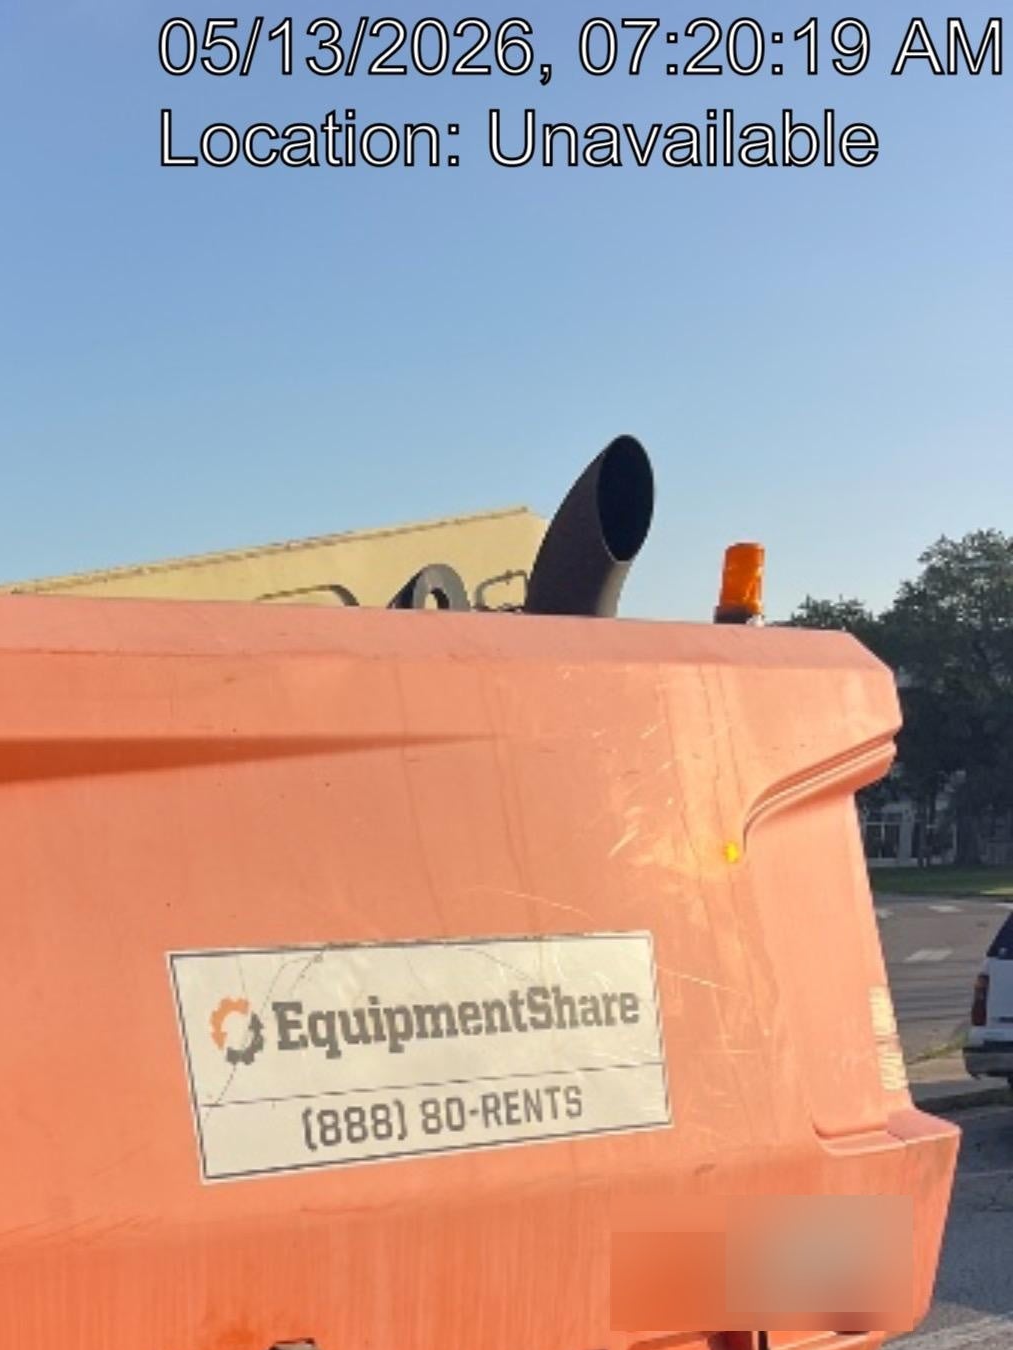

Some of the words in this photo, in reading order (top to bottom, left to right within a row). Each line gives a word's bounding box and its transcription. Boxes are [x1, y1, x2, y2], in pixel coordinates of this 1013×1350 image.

[271, 984, 640, 1059] EquipmentShare
[301, 1098, 408, 1152] (888)
[421, 1085, 584, 1135] 80-RENTS
